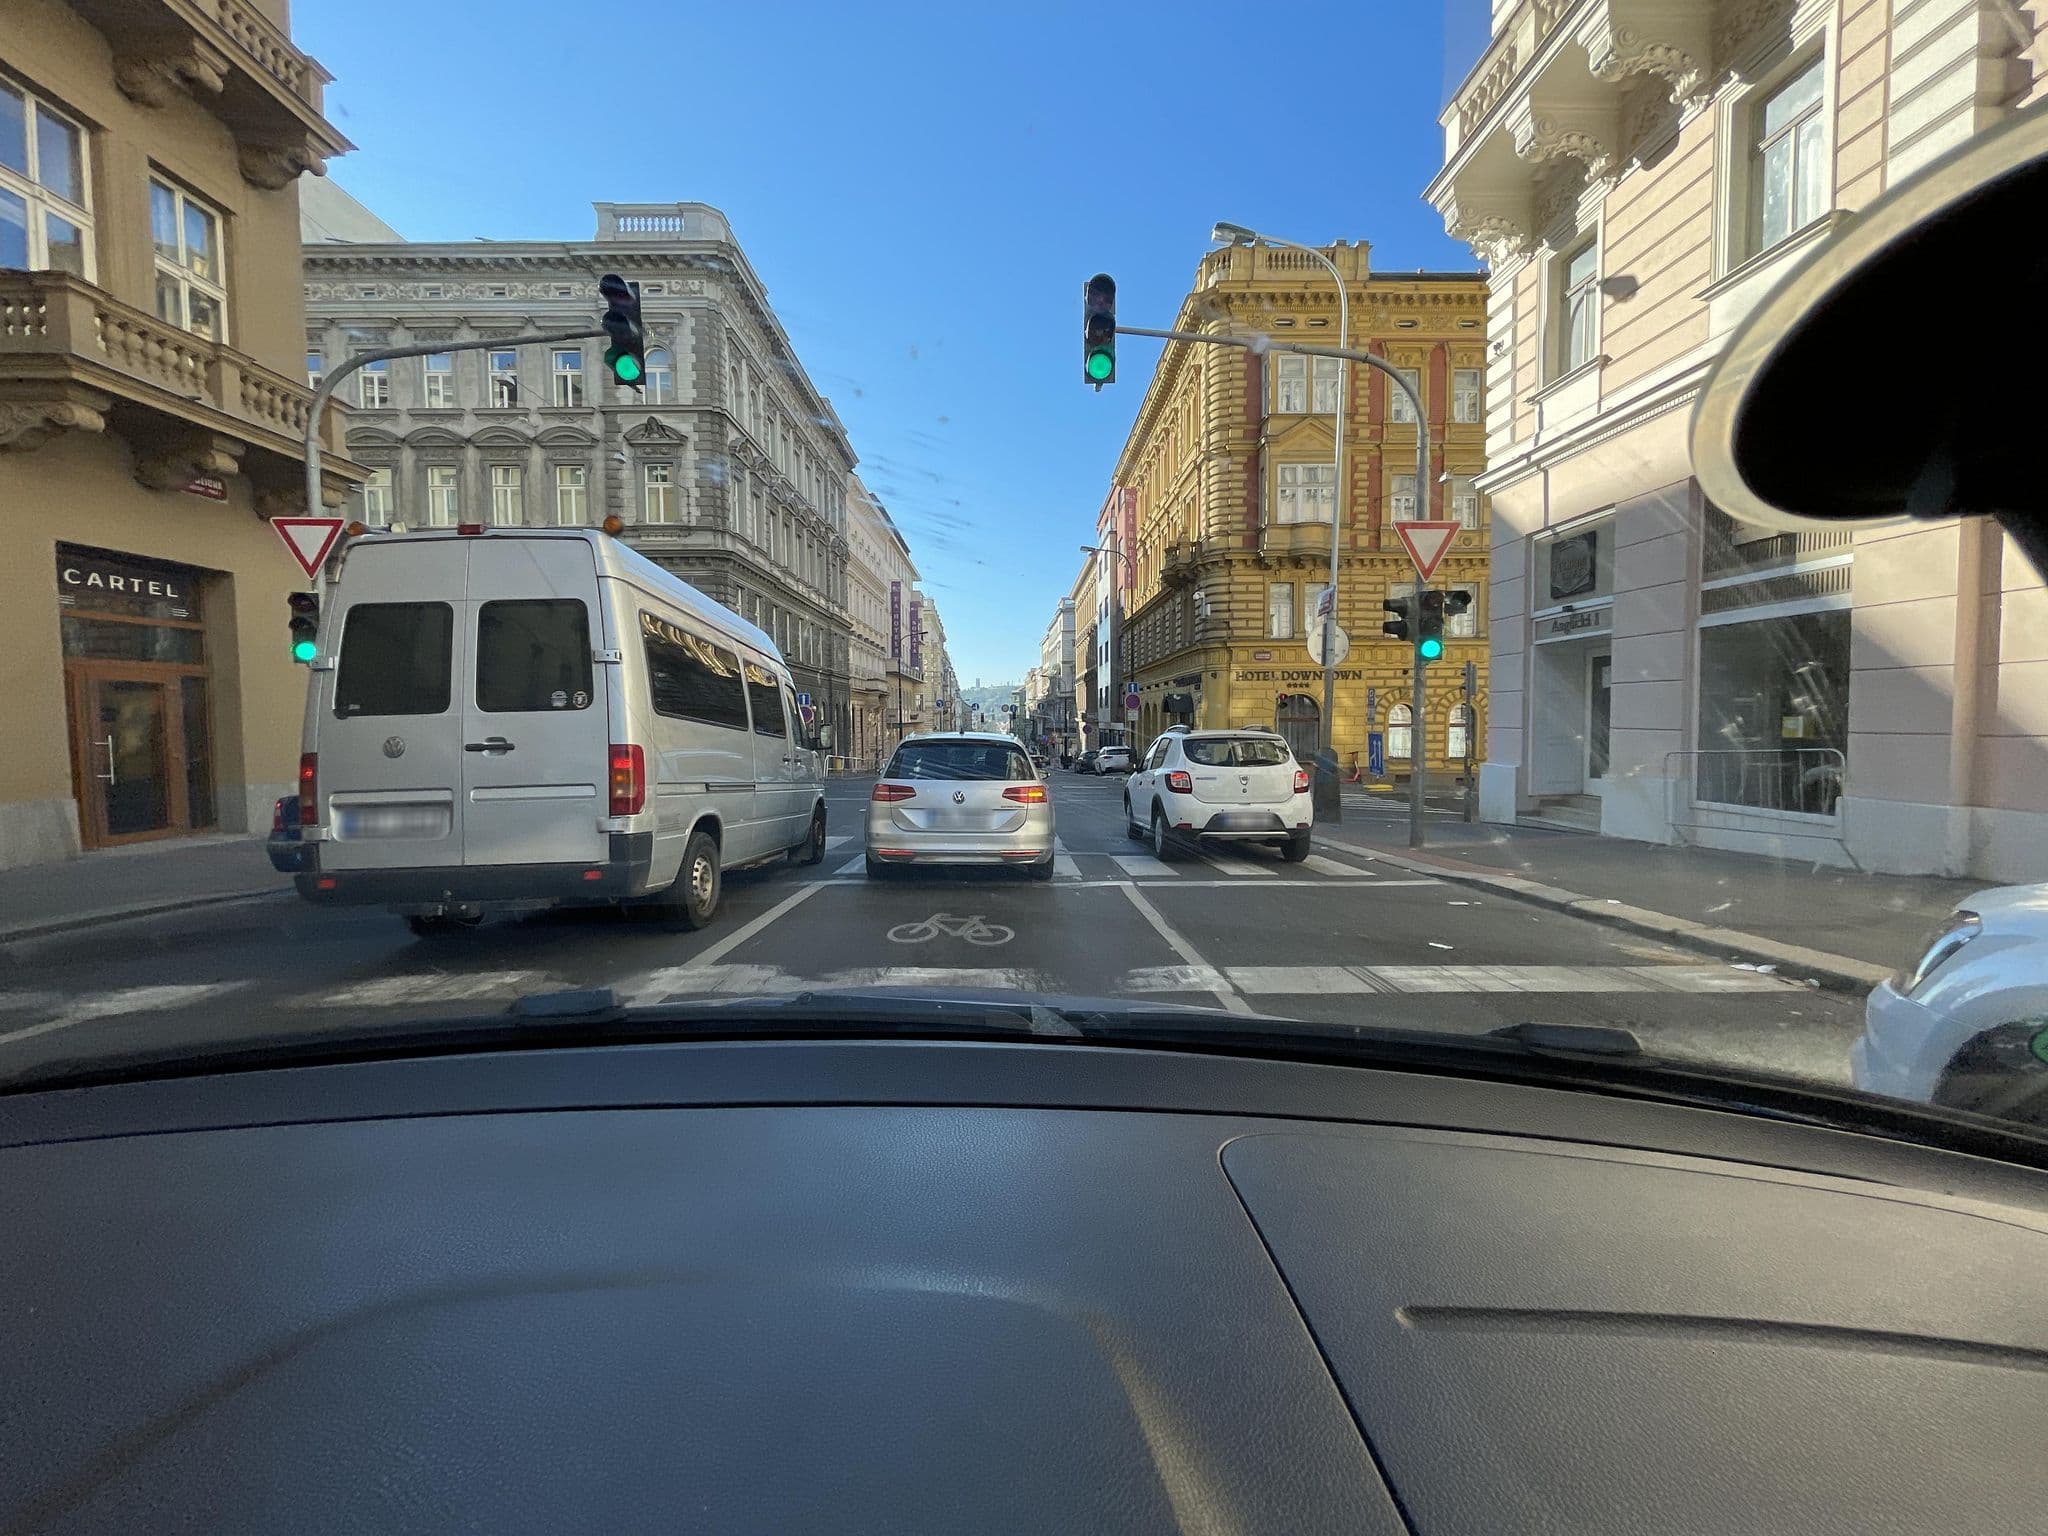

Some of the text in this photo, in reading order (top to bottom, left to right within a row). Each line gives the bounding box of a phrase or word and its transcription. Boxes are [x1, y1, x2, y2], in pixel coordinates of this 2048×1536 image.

[64, 568, 178, 597] CARTEL
[1236, 670, 1362, 681] HOTEL DOWNOWN
